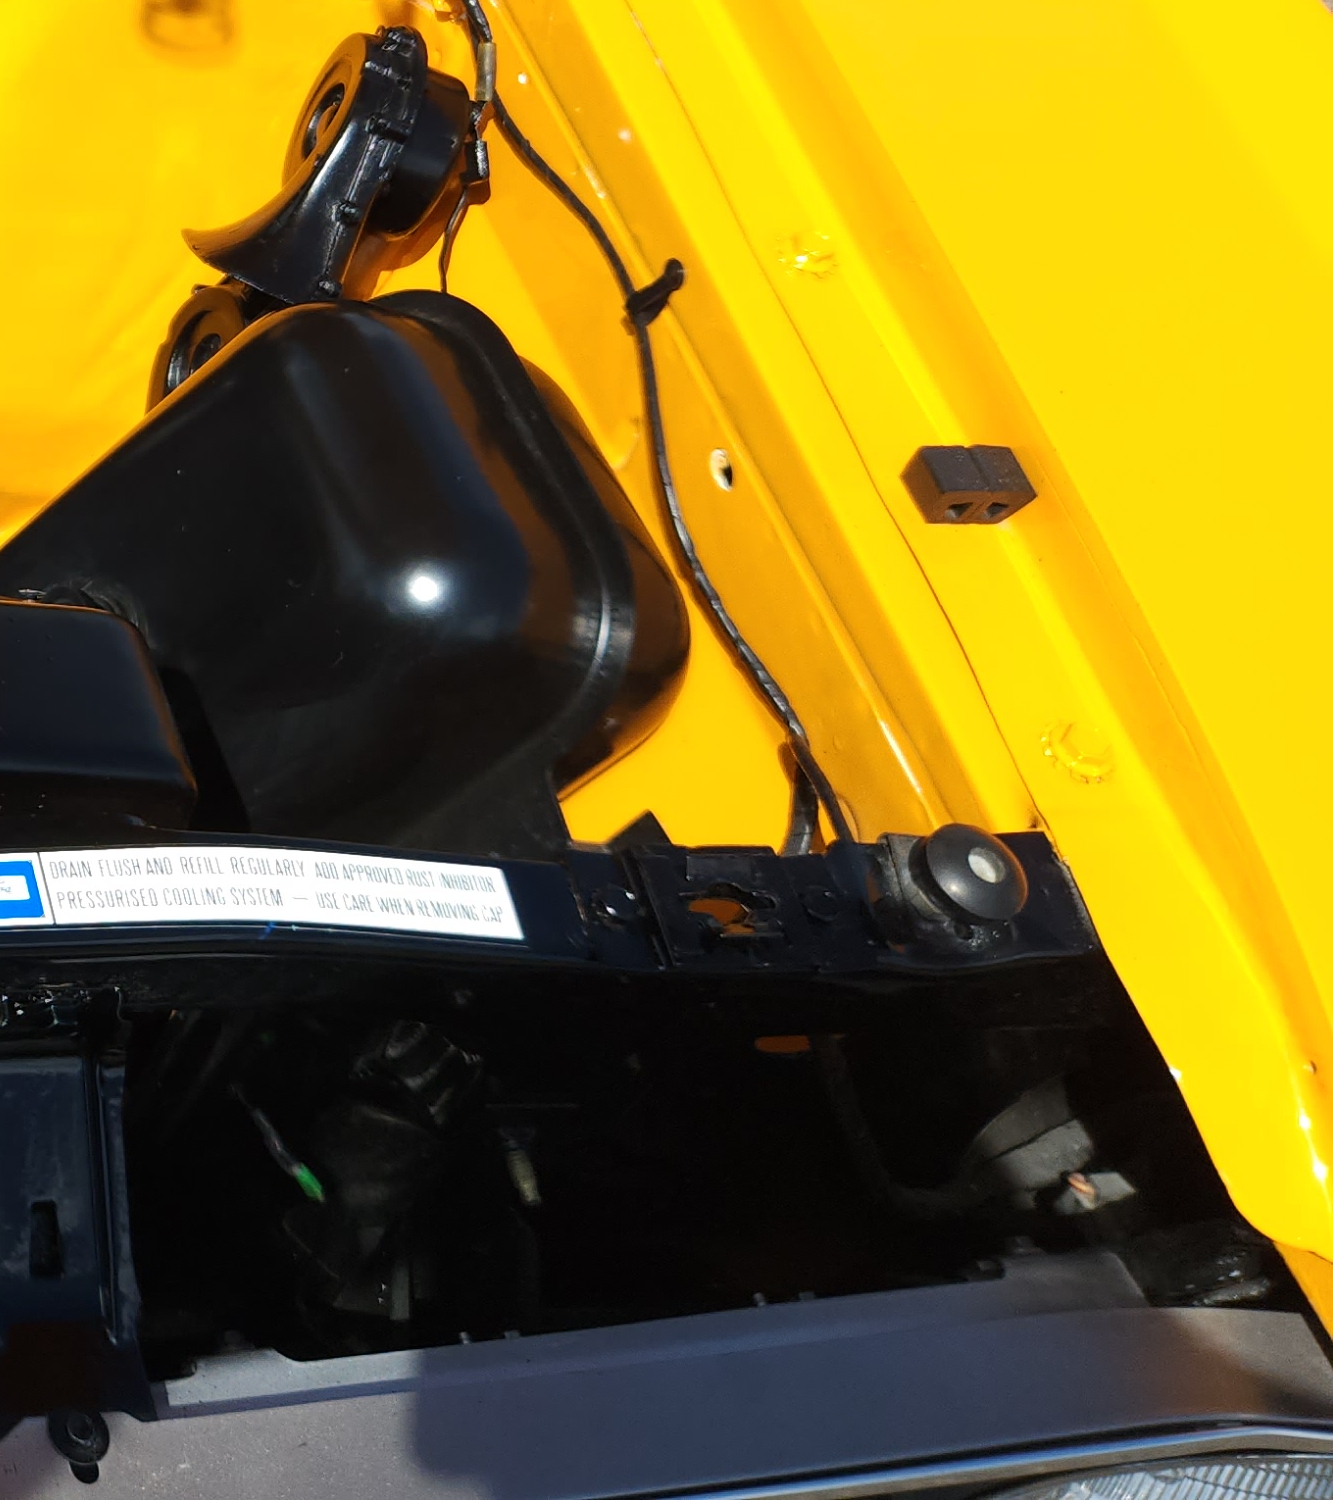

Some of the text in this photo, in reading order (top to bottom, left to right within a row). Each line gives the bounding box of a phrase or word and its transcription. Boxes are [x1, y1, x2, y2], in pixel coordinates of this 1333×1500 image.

[48, 856, 498, 894] DRAIN FLUSH AND REFILL REGULARLY ADD APPROVED RUST INHIBITOR
[56, 887, 159, 911] PRESSURISED
[163, 888, 227, 908] COOLING
[229, 887, 285, 908] SYSTEM
[316, 892, 342, 911] USE
[343, 894, 376, 914] CARE
[377, 896, 415, 917] WHEN
[417, 898, 480, 923] REMOVING
[482, 905, 504, 924] CAP
